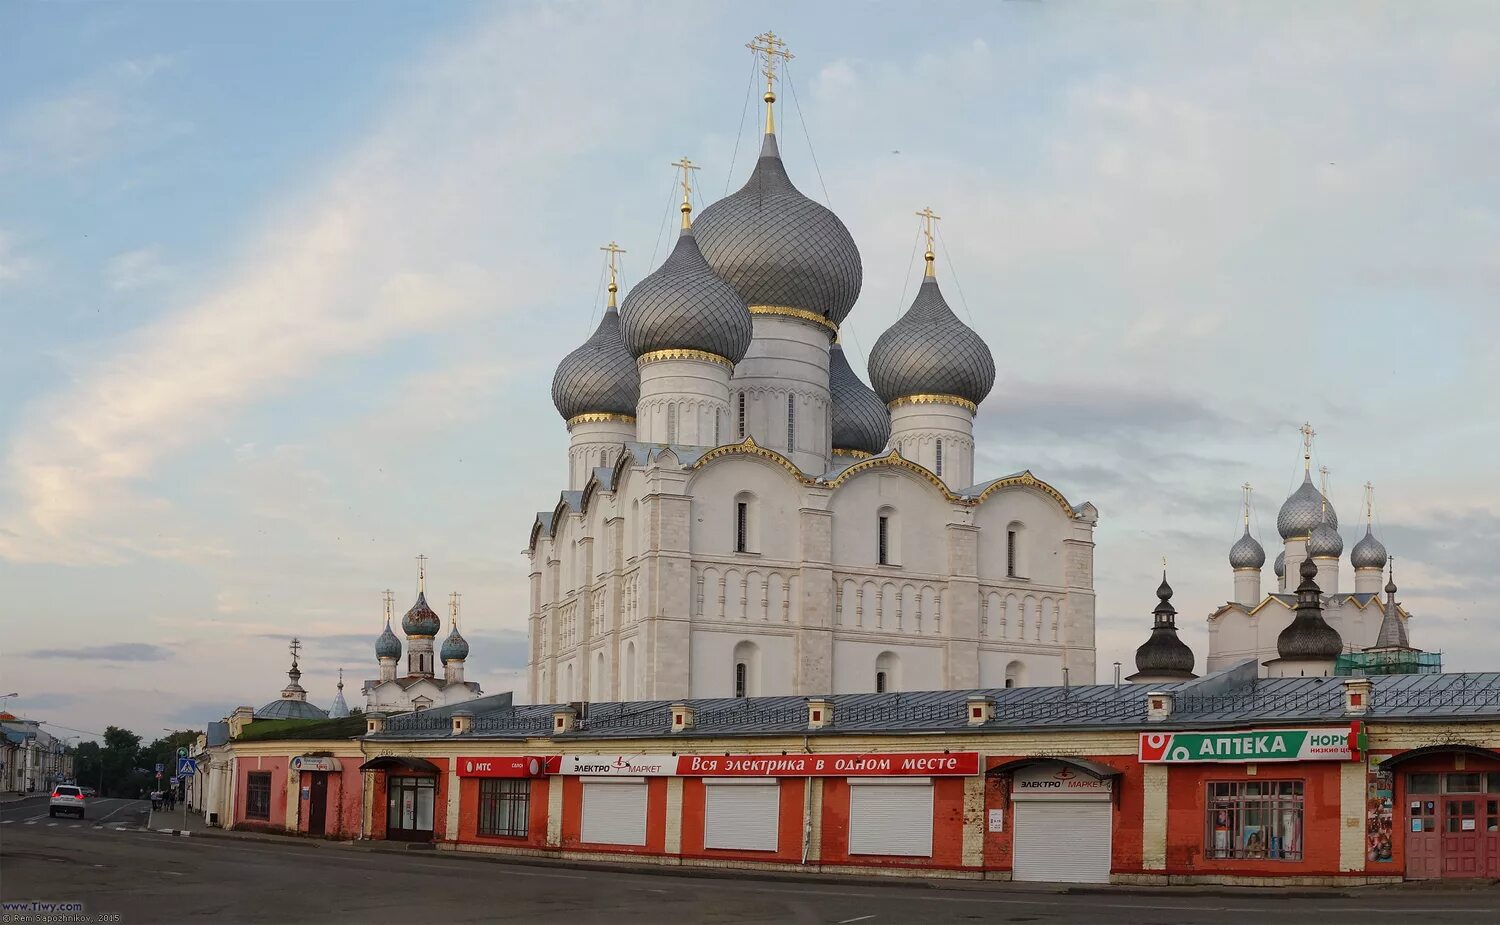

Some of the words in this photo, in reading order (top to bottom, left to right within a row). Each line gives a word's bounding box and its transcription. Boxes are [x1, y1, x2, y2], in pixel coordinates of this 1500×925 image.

[1199, 735, 1287, 755] АПТЕКА
[475, 763, 492, 772] МТС
[627, 764, 662, 773] МАРКЕТ
[691, 757, 718, 771] Вся
[724, 759, 806, 775] электрика
[815, 759, 825, 770] в
[834, 757, 891, 771] одном
[901, 756, 957, 770] месте
